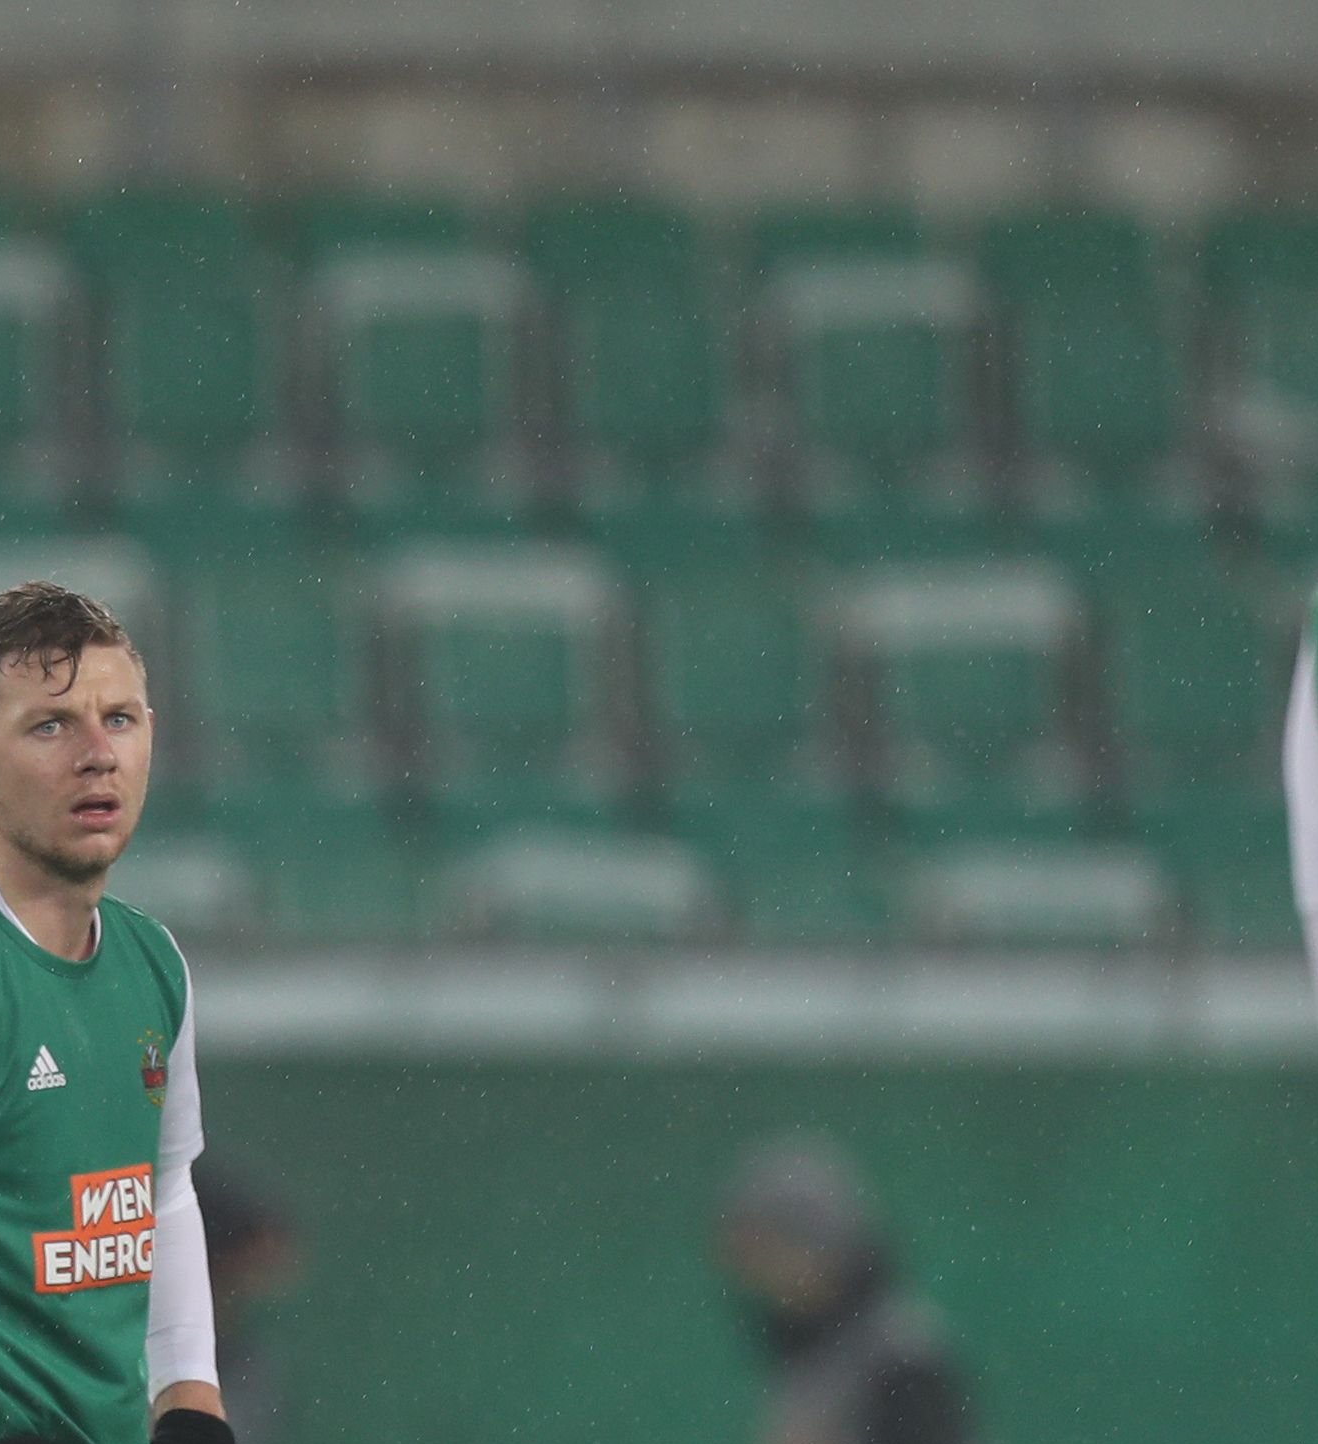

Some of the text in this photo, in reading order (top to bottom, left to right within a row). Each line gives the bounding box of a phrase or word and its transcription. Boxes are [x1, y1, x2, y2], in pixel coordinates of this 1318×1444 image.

[27, 1072, 67, 1091] adidas
[81, 1174, 153, 1227] WIEN
[44, 1229, 155, 1286] ENERG
